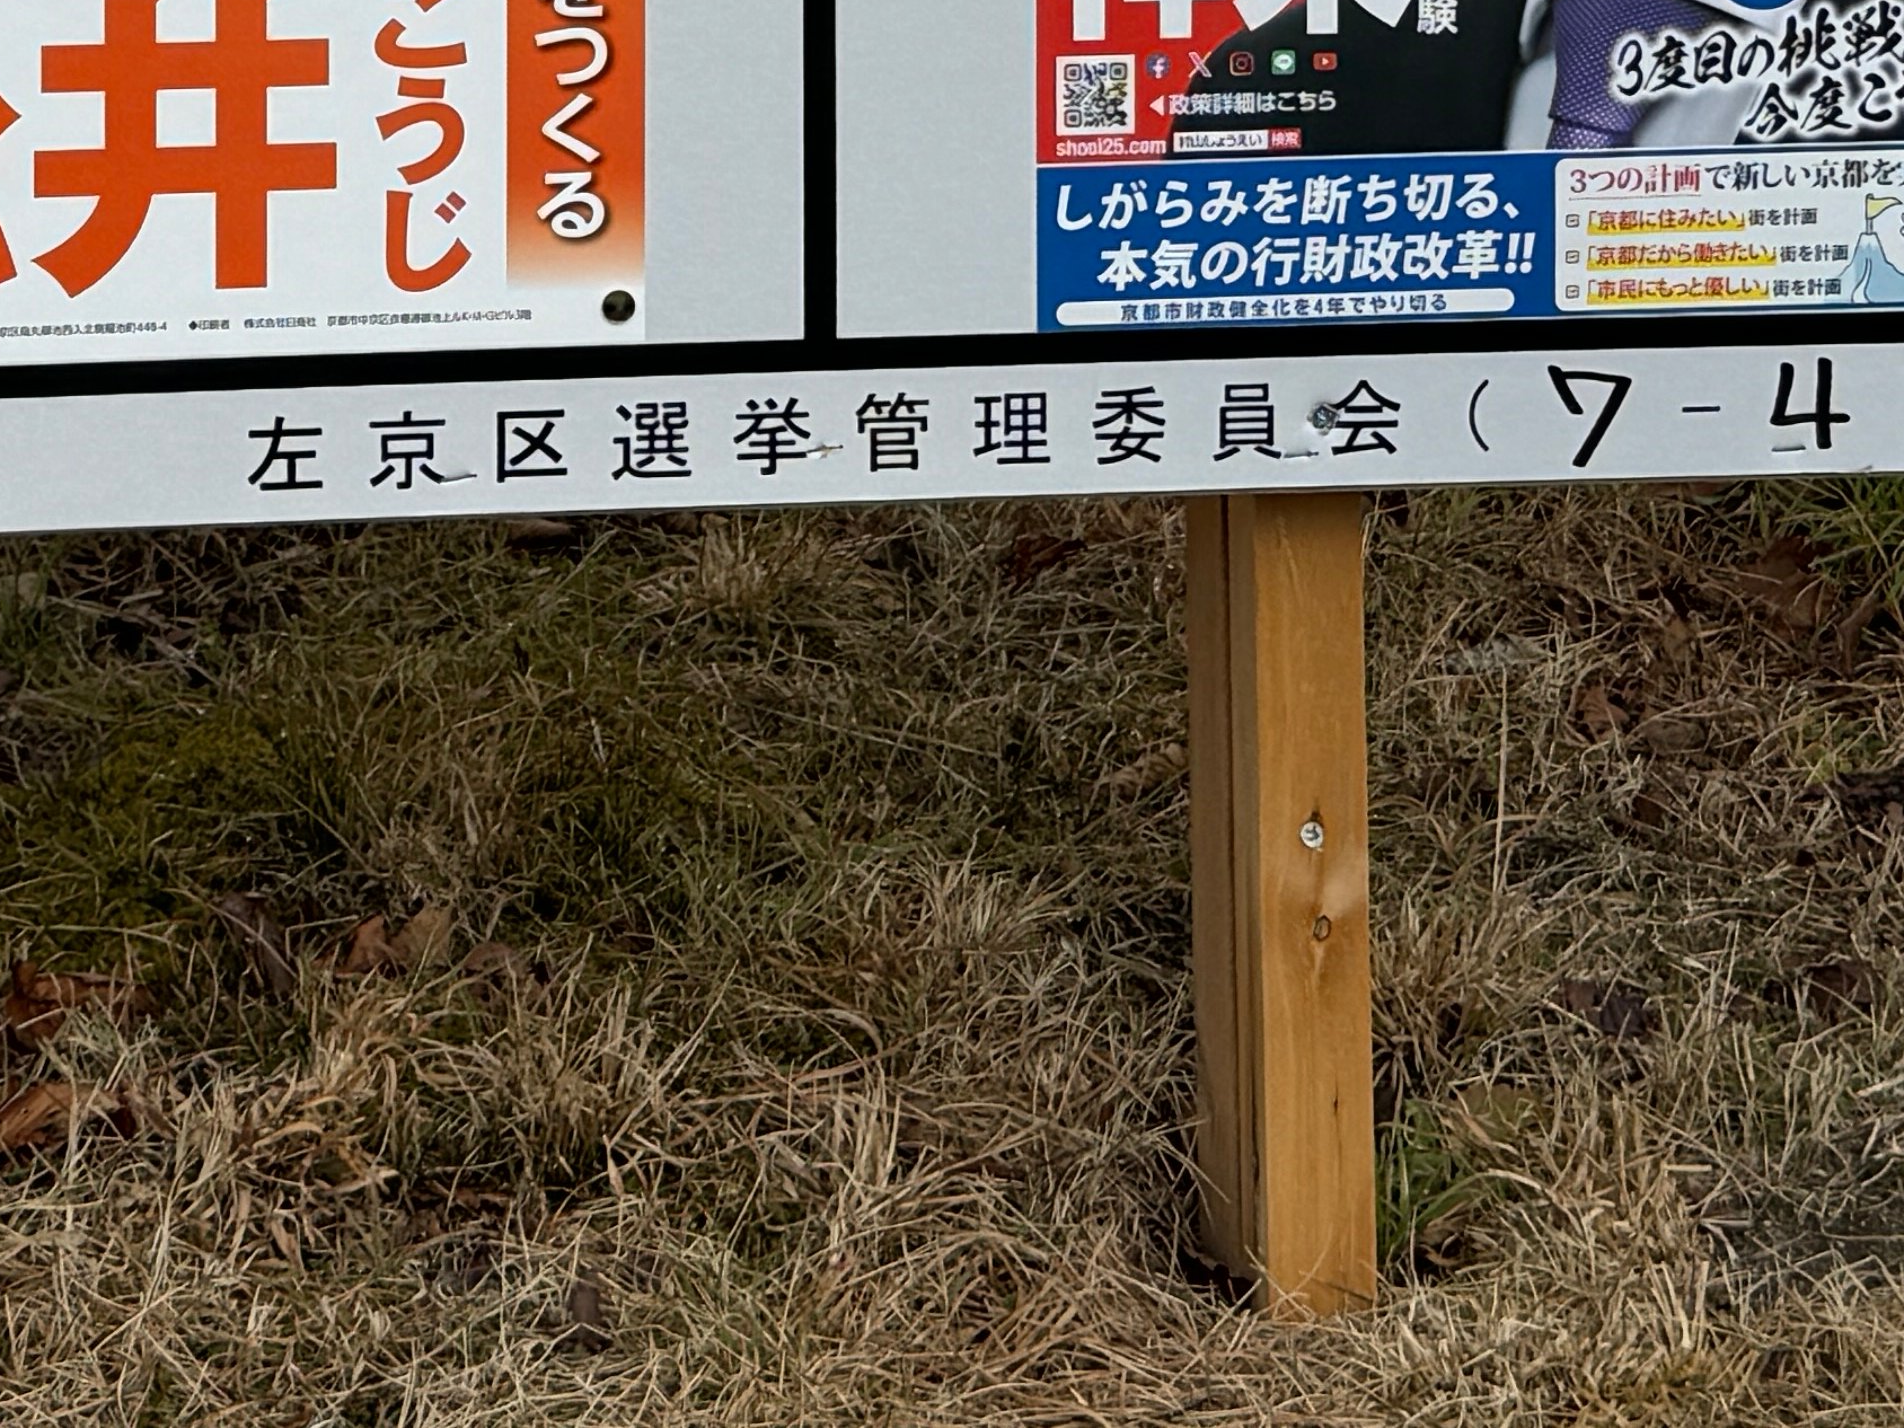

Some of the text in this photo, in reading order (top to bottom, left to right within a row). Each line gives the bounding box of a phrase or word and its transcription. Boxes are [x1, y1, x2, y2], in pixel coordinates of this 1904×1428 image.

[1169, 90, 1338, 116] 政策詳細はこちら
[1056, 172, 1524, 231] しがらみを断ち切る、
[1120, 293, 1449, 323] 京都市財政健全化を4年でやり切る
